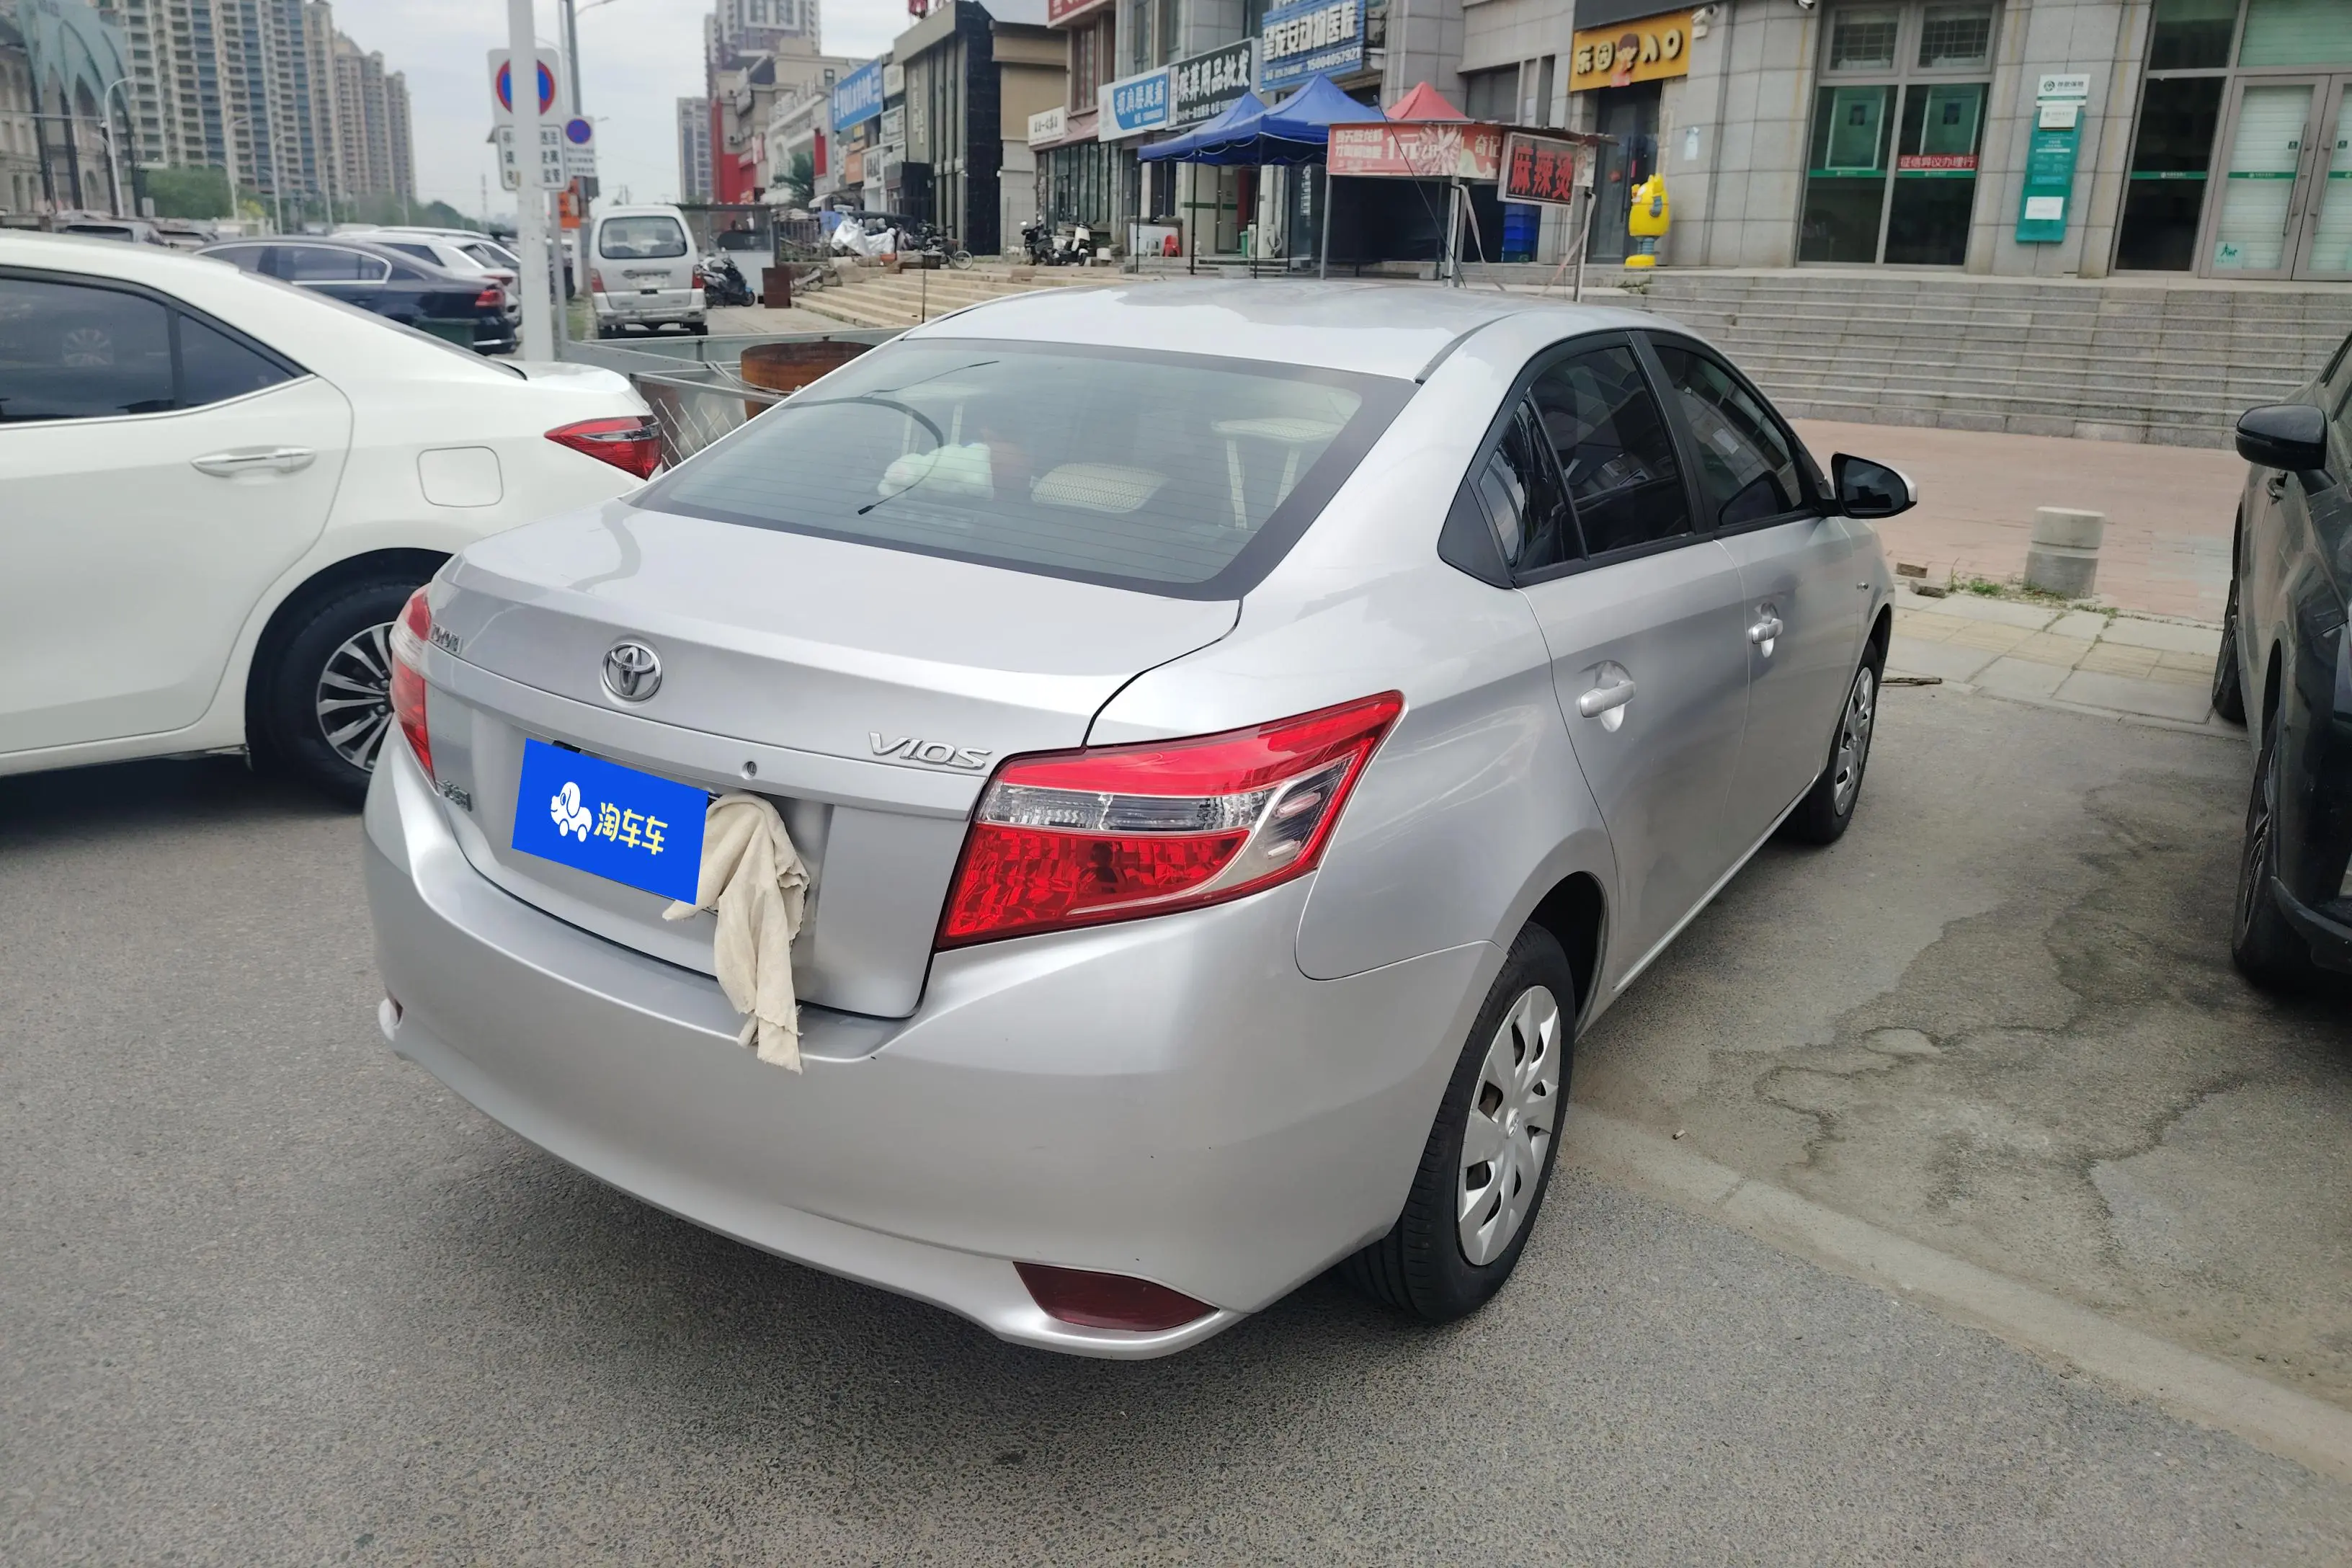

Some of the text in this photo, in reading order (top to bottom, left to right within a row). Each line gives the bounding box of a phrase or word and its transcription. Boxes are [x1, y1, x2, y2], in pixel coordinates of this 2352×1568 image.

[1510, 145, 1573, 200] 麻辣烫
[868, 731, 992, 770] VIOS
